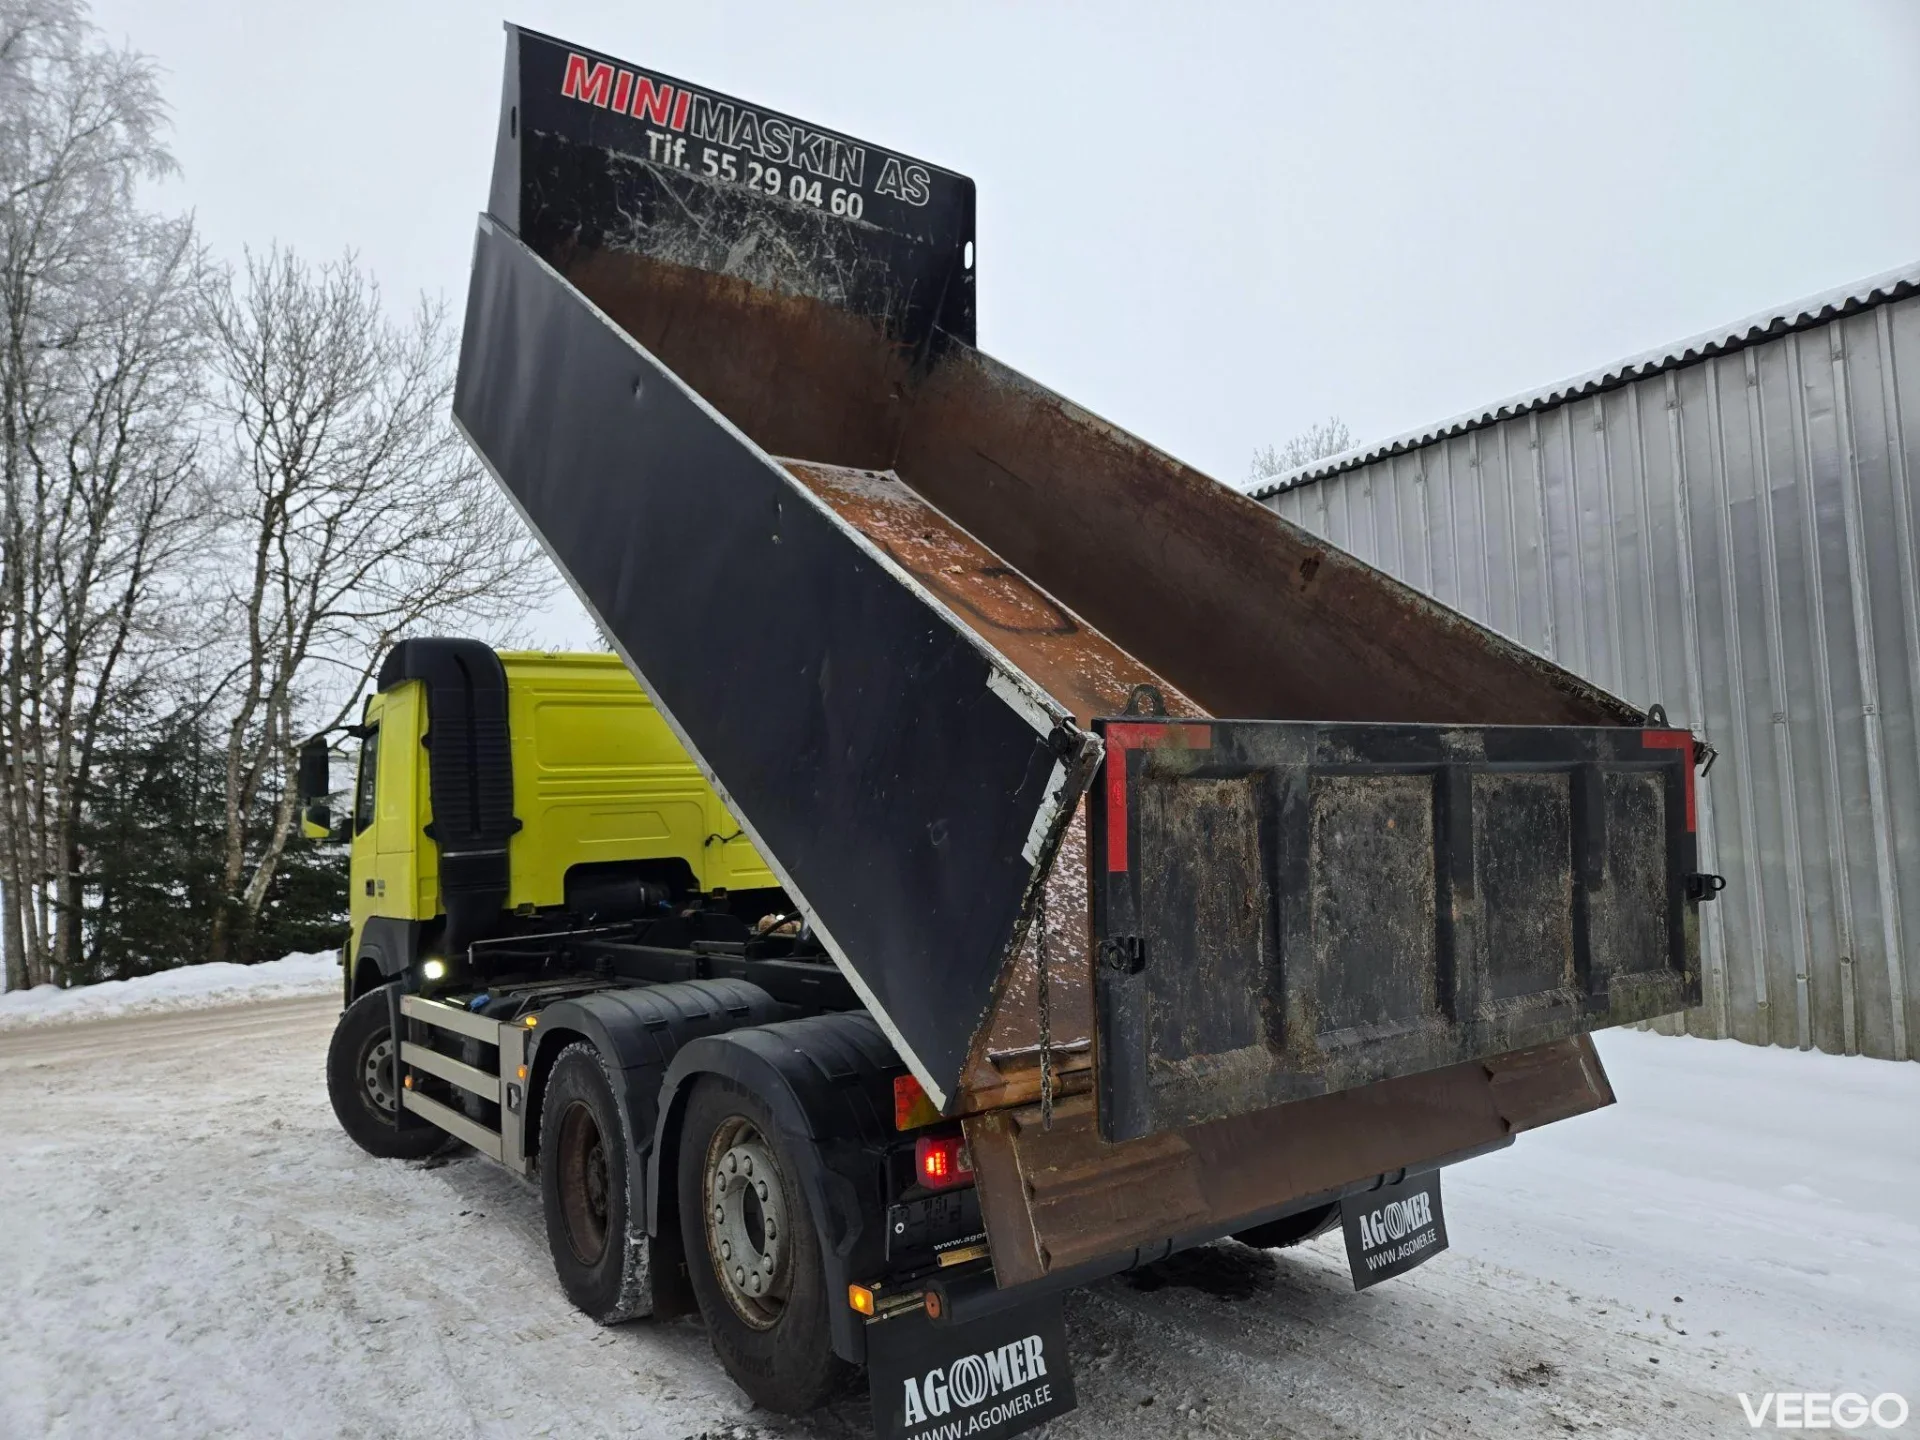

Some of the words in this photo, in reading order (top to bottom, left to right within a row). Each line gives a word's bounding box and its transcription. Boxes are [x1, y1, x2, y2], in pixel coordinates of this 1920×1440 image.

[561, 52, 865, 188] MINIMASKIN
[875, 157, 931, 207] AS
[702, 147, 737, 182] 55
[748, 162, 782, 196] 29
[789, 175, 823, 208] 04
[831, 188, 863, 220] 60
[1359, 1191, 1433, 1252] AGOMER
[1366, 1228, 1437, 1271] WWW.AGOMER.EE
[903, 1334, 1048, 1428] AGOMER
